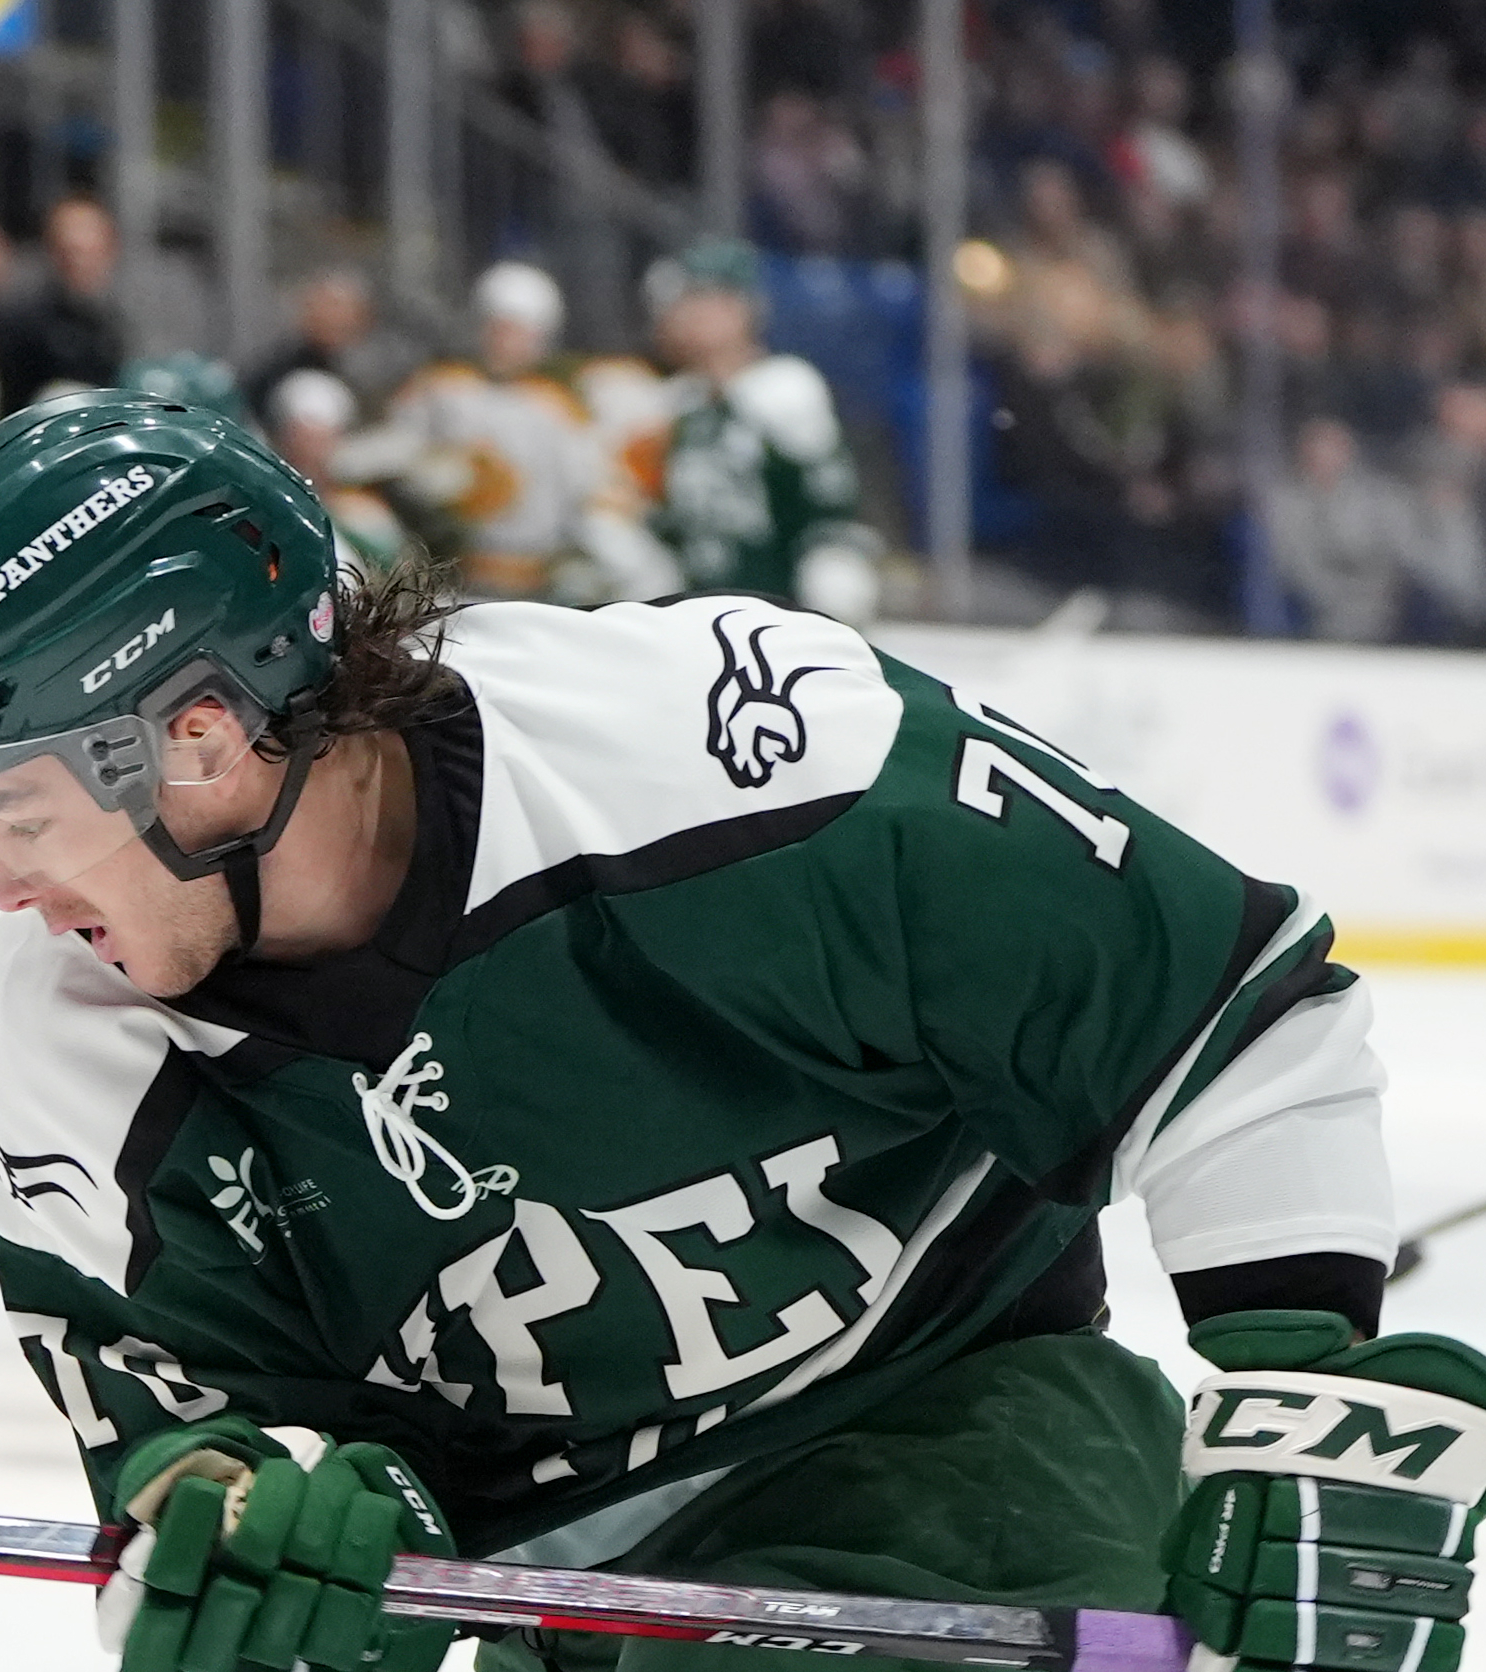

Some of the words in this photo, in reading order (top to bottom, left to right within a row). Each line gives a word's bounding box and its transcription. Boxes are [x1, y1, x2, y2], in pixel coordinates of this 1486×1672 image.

[79, 608, 176, 694] CCM
[385, 1465, 442, 1536] CCM
[763, 1600, 842, 1618] TEAM
[704, 1630, 867, 1656] CCM
